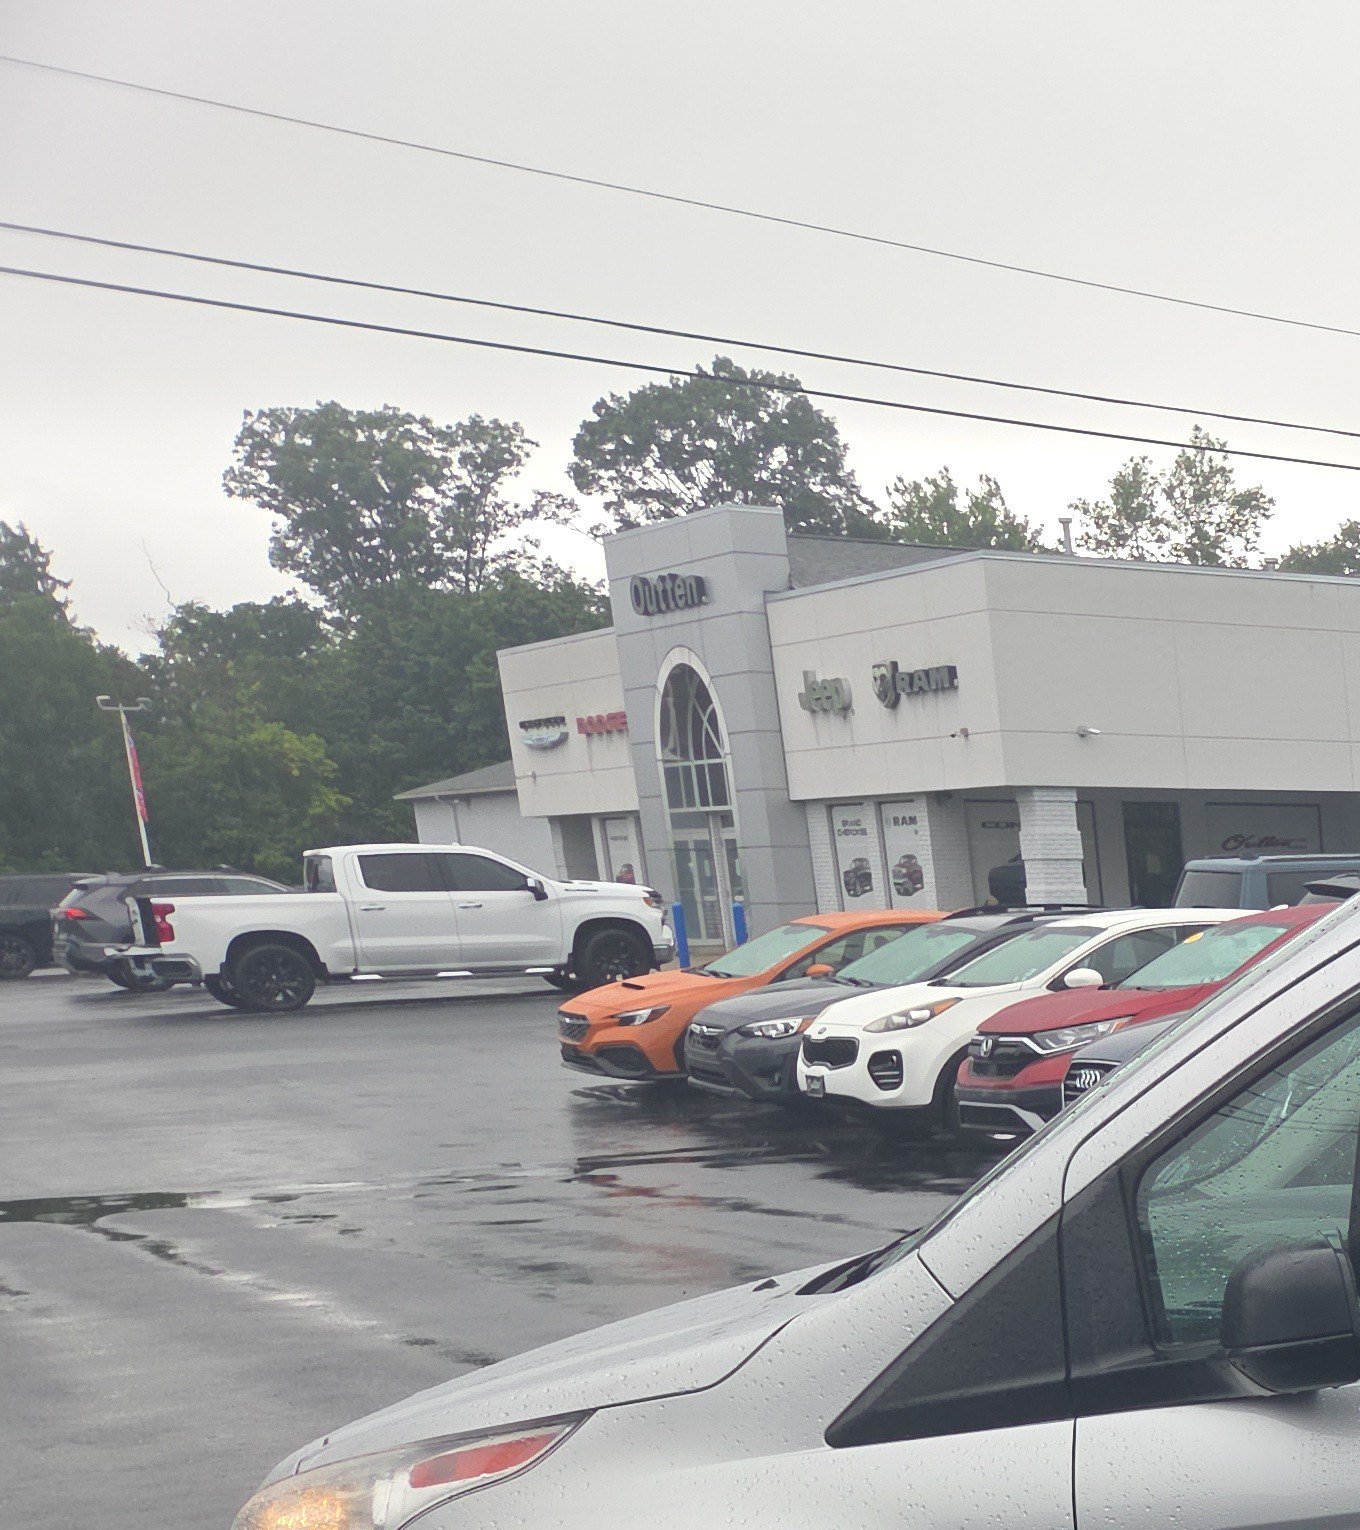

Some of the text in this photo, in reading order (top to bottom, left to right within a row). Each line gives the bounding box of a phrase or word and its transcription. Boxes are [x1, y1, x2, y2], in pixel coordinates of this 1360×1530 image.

[630, 573, 704, 616] Outten
[798, 665, 955, 716] Jeep RAM
